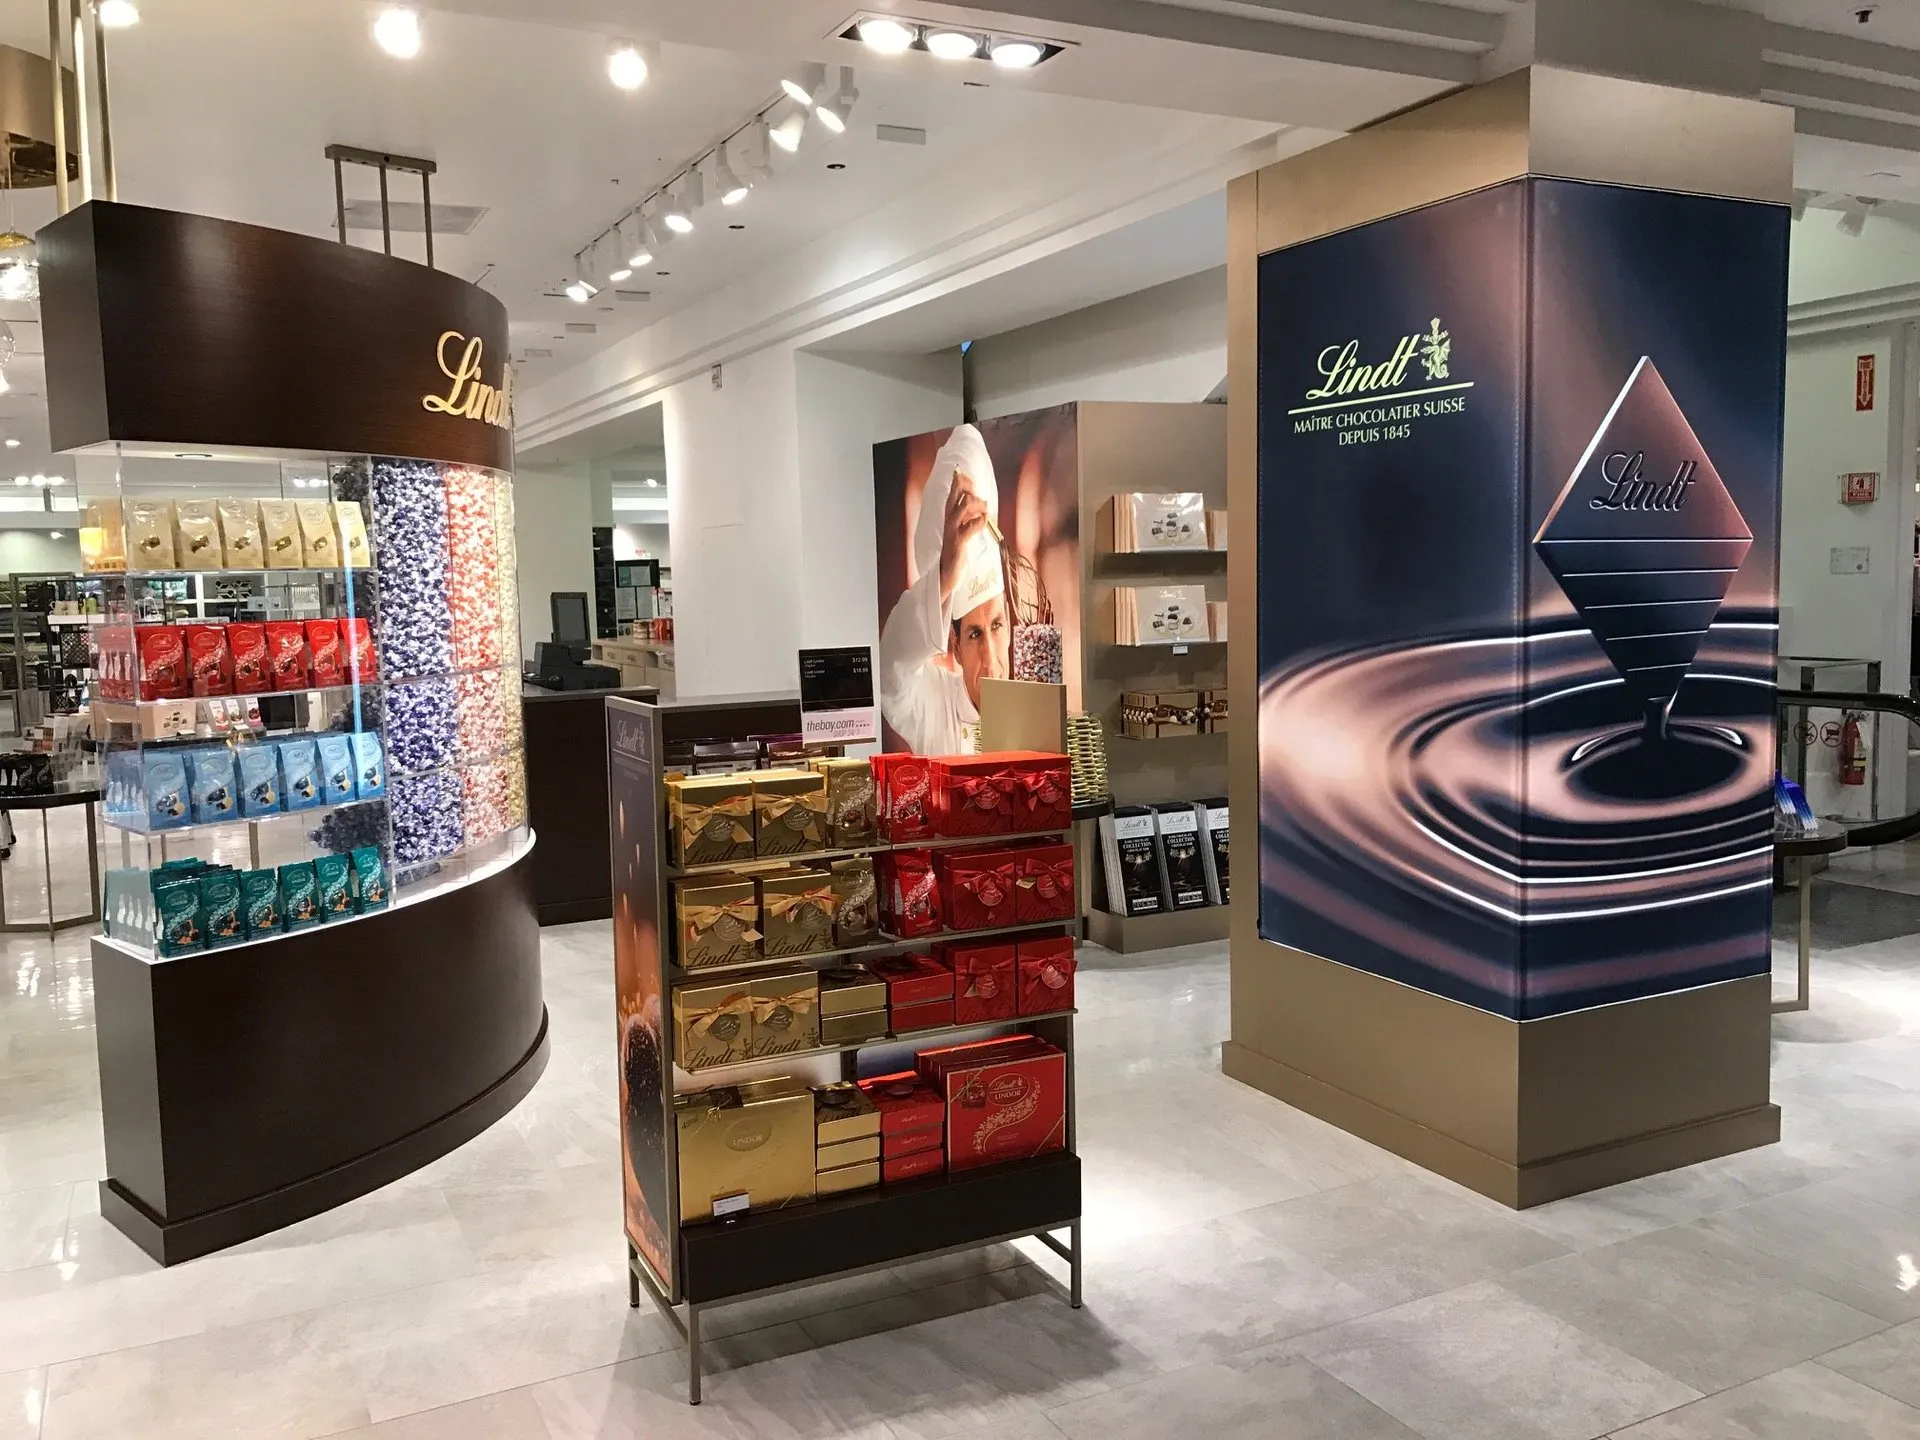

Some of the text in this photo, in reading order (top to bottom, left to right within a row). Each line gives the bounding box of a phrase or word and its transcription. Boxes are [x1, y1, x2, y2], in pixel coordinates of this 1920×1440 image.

[1305, 333, 1421, 400] Lindt
[423, 331, 511, 430] Lind
[1294, 396, 1466, 434] MAÎTRE CHOCOLATIER SUISSE
[1338, 424, 1411, 446] DEPUIS 1845
[1589, 450, 1698, 512] Lindt
[806, 720, 854, 733] thebay.com
[686, 943, 741, 967] Lindt
[765, 934, 818, 957] Lindt
[754, 1036, 803, 1058] Lindt
[684, 1048, 737, 1070] Lindt
[994, 1090, 1021, 1100] LINDOR
[732, 1134, 764, 1147] LINDOR
